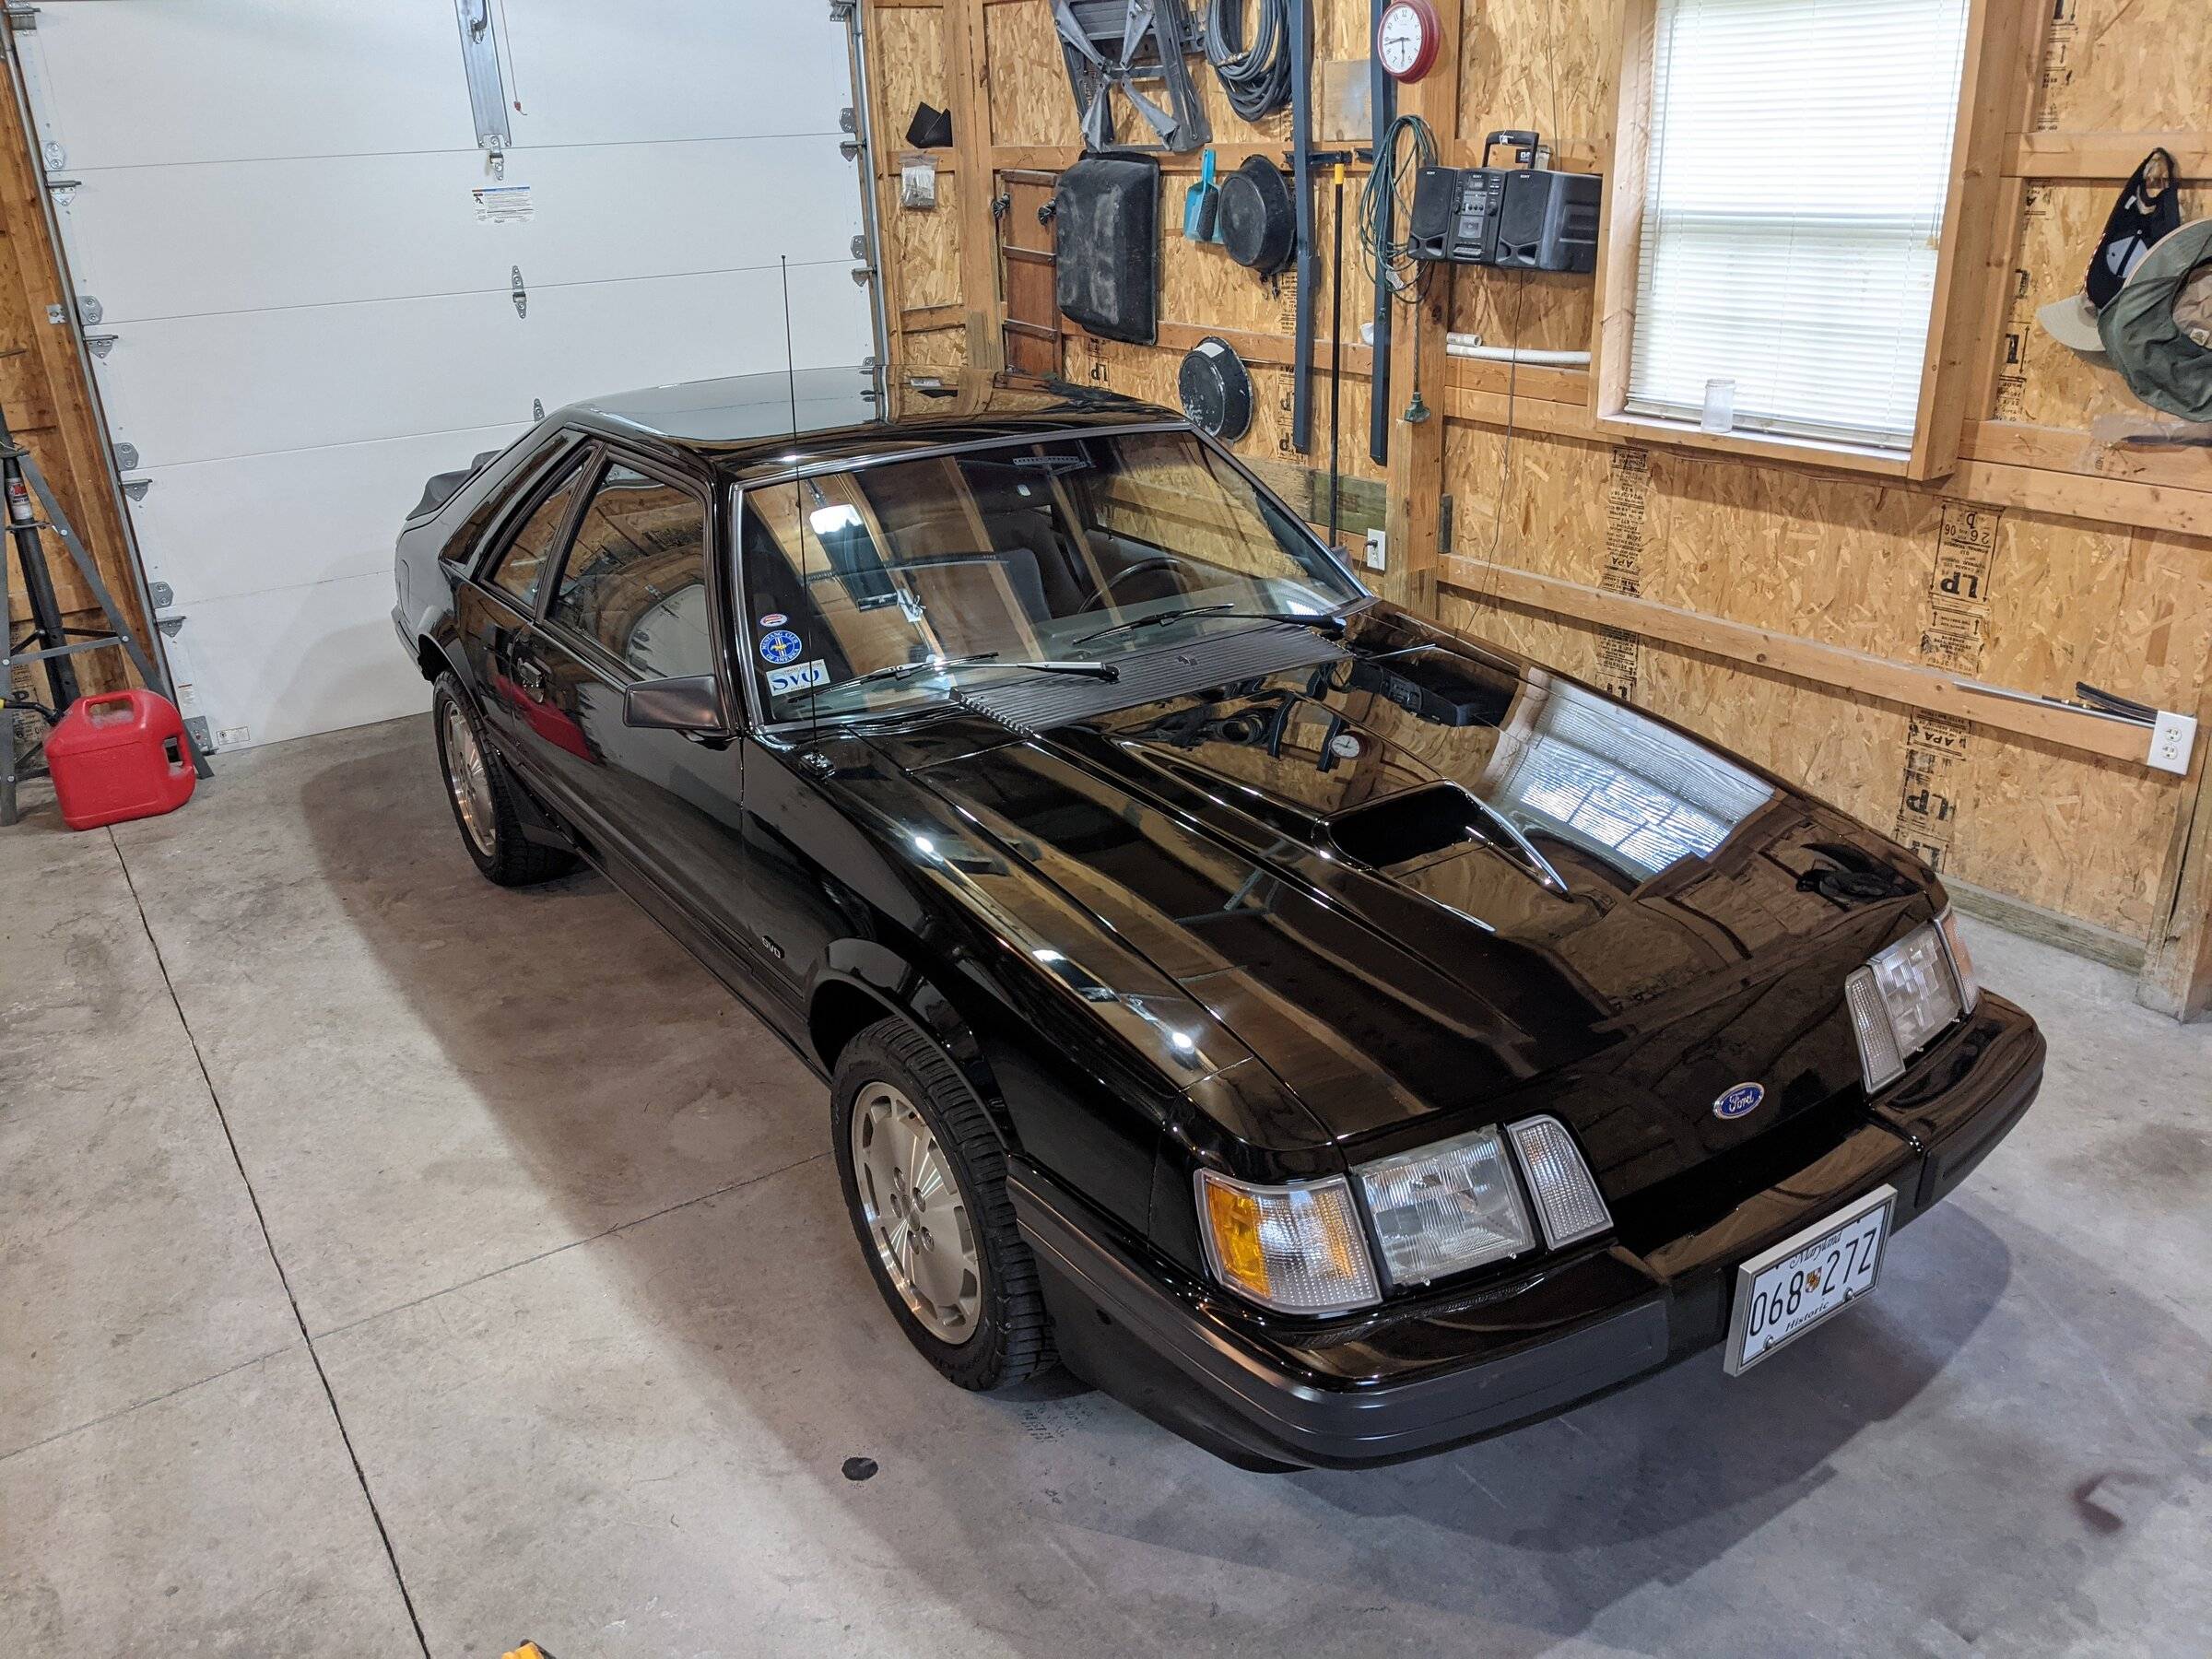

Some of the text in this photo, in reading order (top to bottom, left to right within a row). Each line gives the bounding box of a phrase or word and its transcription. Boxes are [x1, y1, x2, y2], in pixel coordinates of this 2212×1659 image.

[1091, 362, 1108, 382] LP
[1612, 556, 1633, 568] APA
[1940, 571, 1979, 599] LP
[761, 631, 799, 650] MUSTANG CLUB
[775, 649, 800, 662] AMERICA
[1924, 732, 1955, 747] APA
[1906, 789, 1949, 821] LP
[1729, 1089, 1755, 1112] Ford
[1789, 1230, 1843, 1269] Maryland
[1749, 1270, 1805, 1336] 068
[1784, 1300, 1830, 1333] Historic
